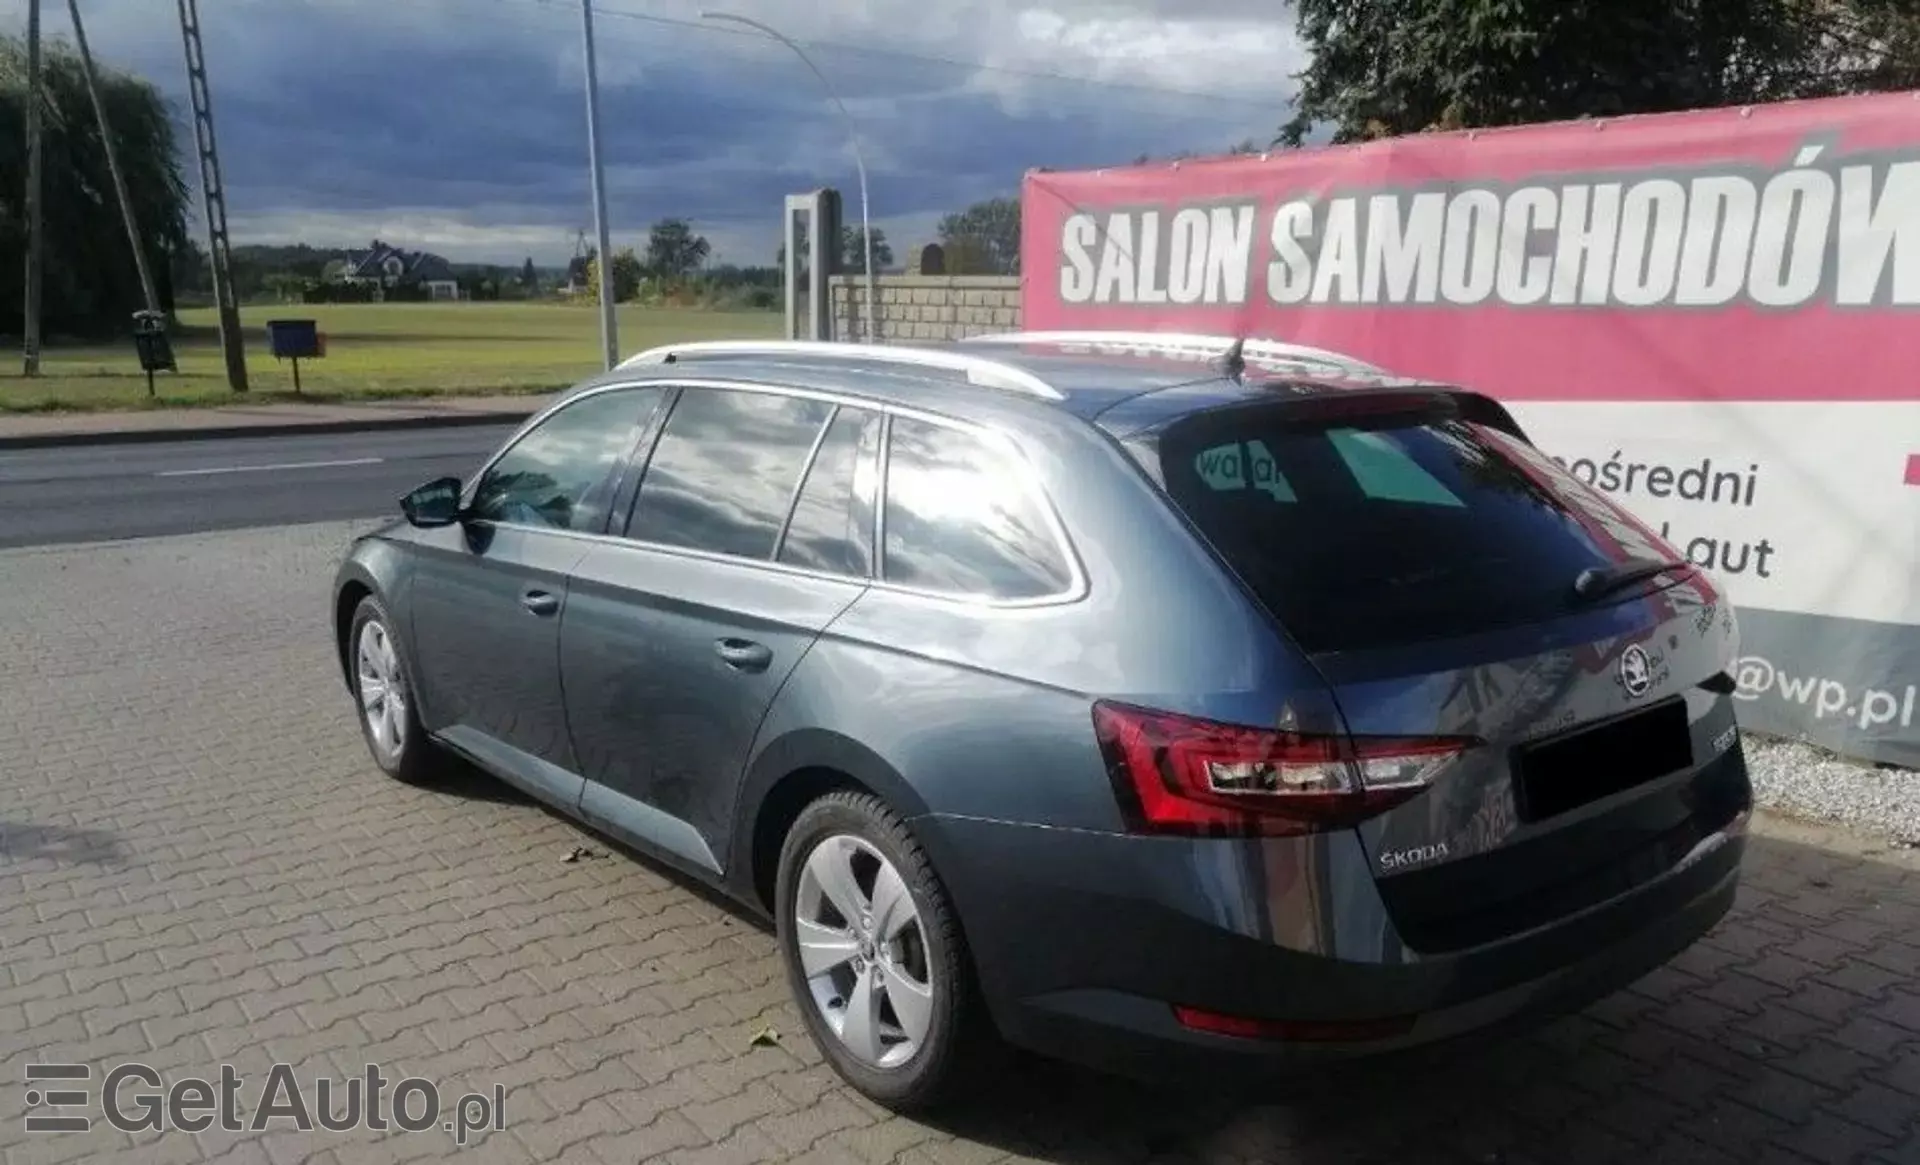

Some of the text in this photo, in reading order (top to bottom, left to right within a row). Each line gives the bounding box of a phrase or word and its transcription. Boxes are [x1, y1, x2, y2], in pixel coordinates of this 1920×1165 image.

[1060, 145, 1920, 307] SALON SAMOCHODÓW
[1552, 450, 1759, 507] ośredni
[1686, 535, 1775, 578] aut
